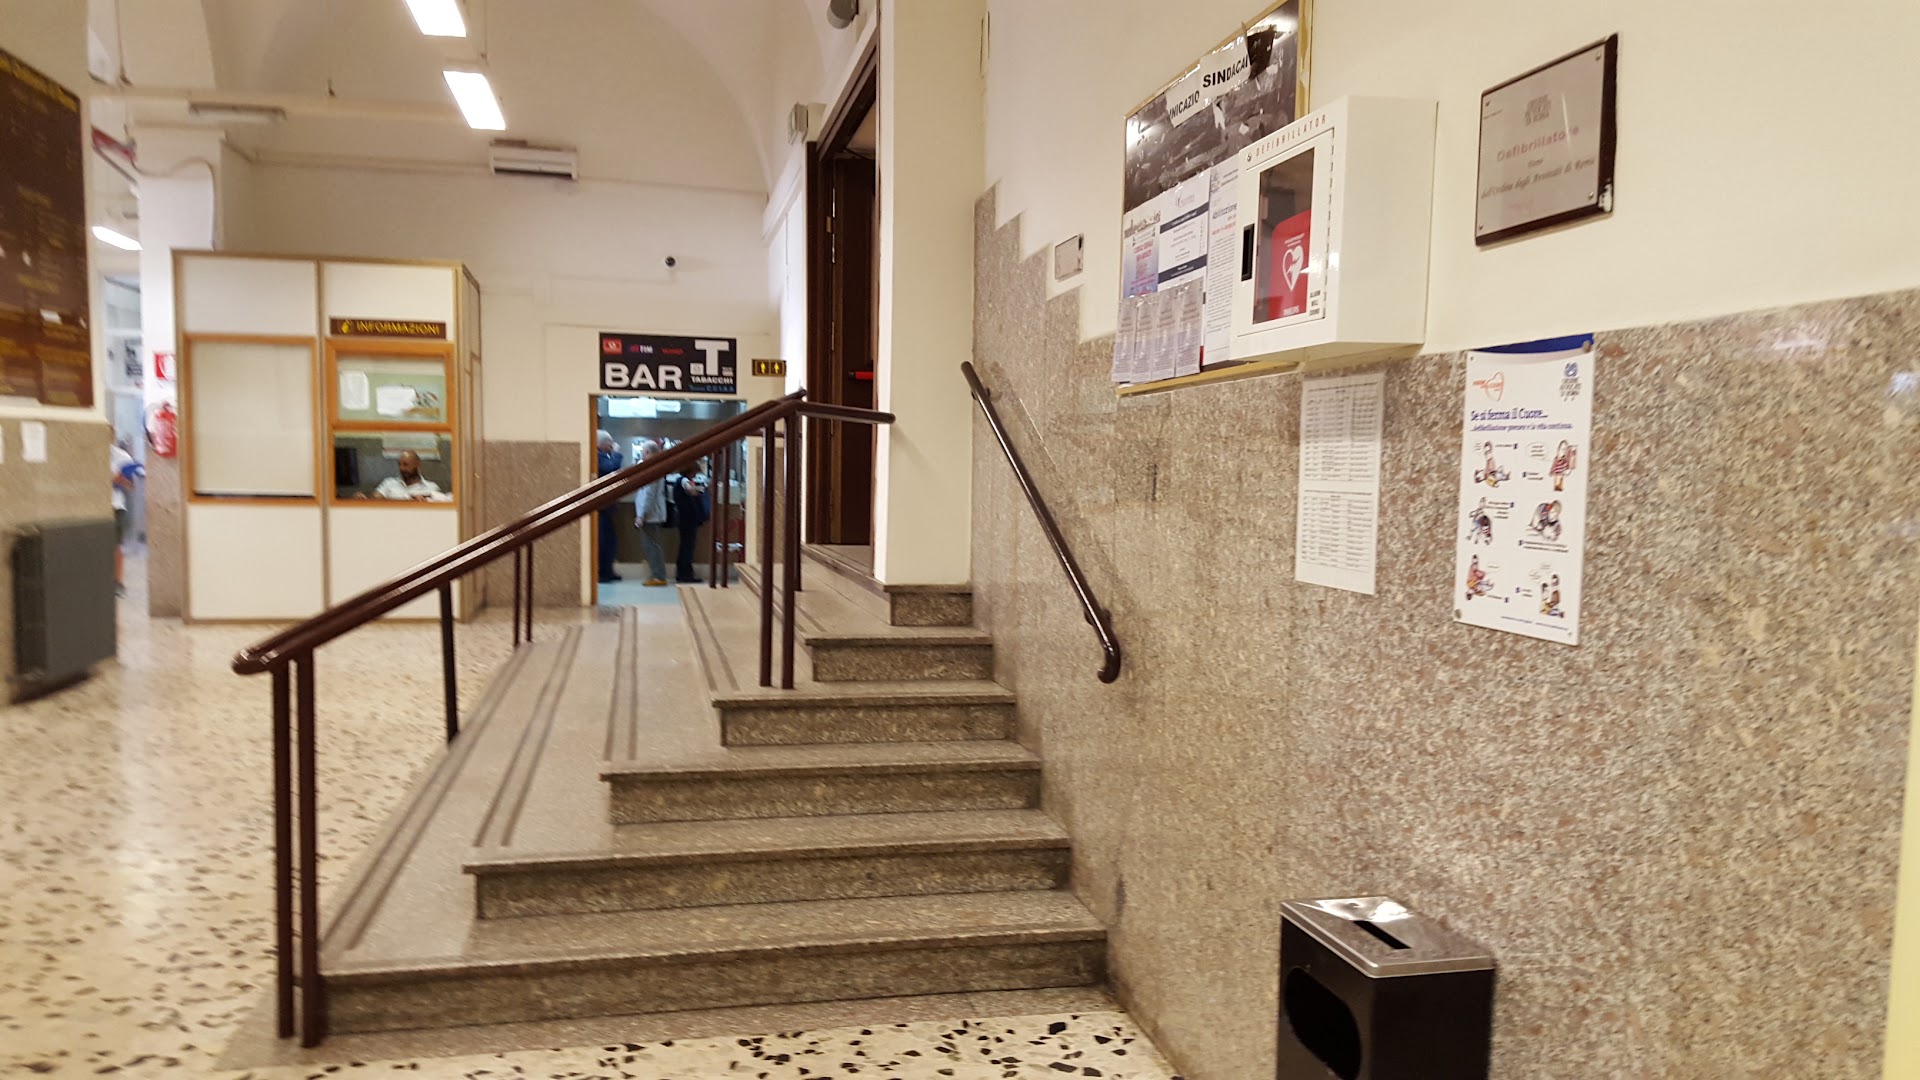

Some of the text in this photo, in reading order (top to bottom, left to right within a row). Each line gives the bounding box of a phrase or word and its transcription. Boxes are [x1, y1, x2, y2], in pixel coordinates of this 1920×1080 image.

[1256, 114, 1326, 157] DEFIBRILLATOR
[356, 320, 440, 335] INFORMAZIONI
[605, 362, 682, 390] BAR
[690, 375, 734, 385] TABACCHI
